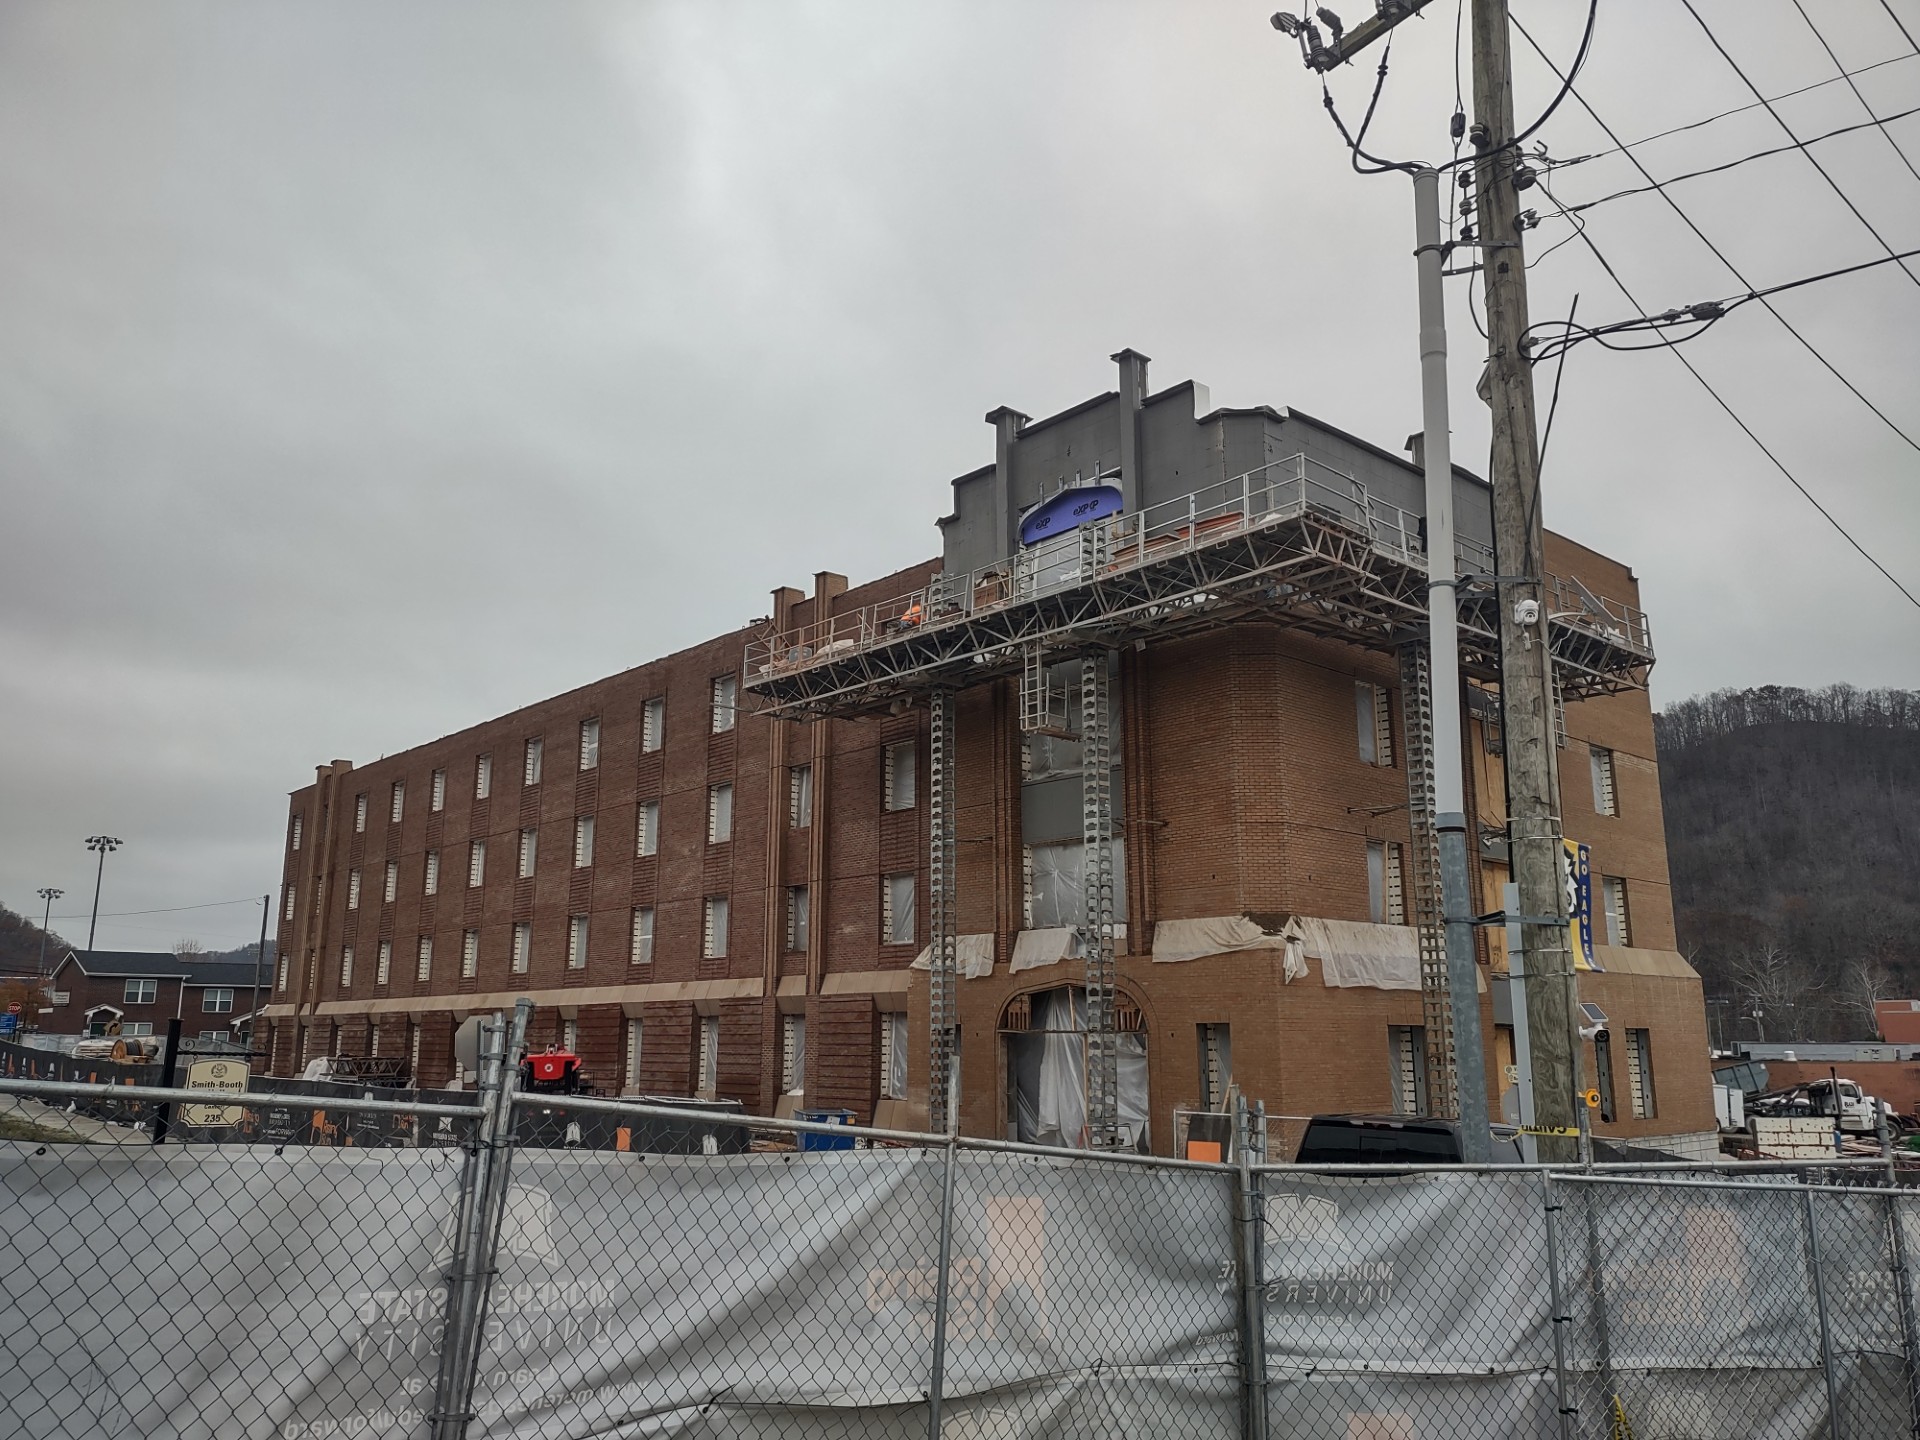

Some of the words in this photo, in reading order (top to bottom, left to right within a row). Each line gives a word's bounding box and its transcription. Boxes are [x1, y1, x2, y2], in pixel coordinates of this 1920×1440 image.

[1580, 849, 1588, 876] GO
[191, 1080, 244, 1089] Smith-Booth
[203, 1114, 221, 1123] 235
